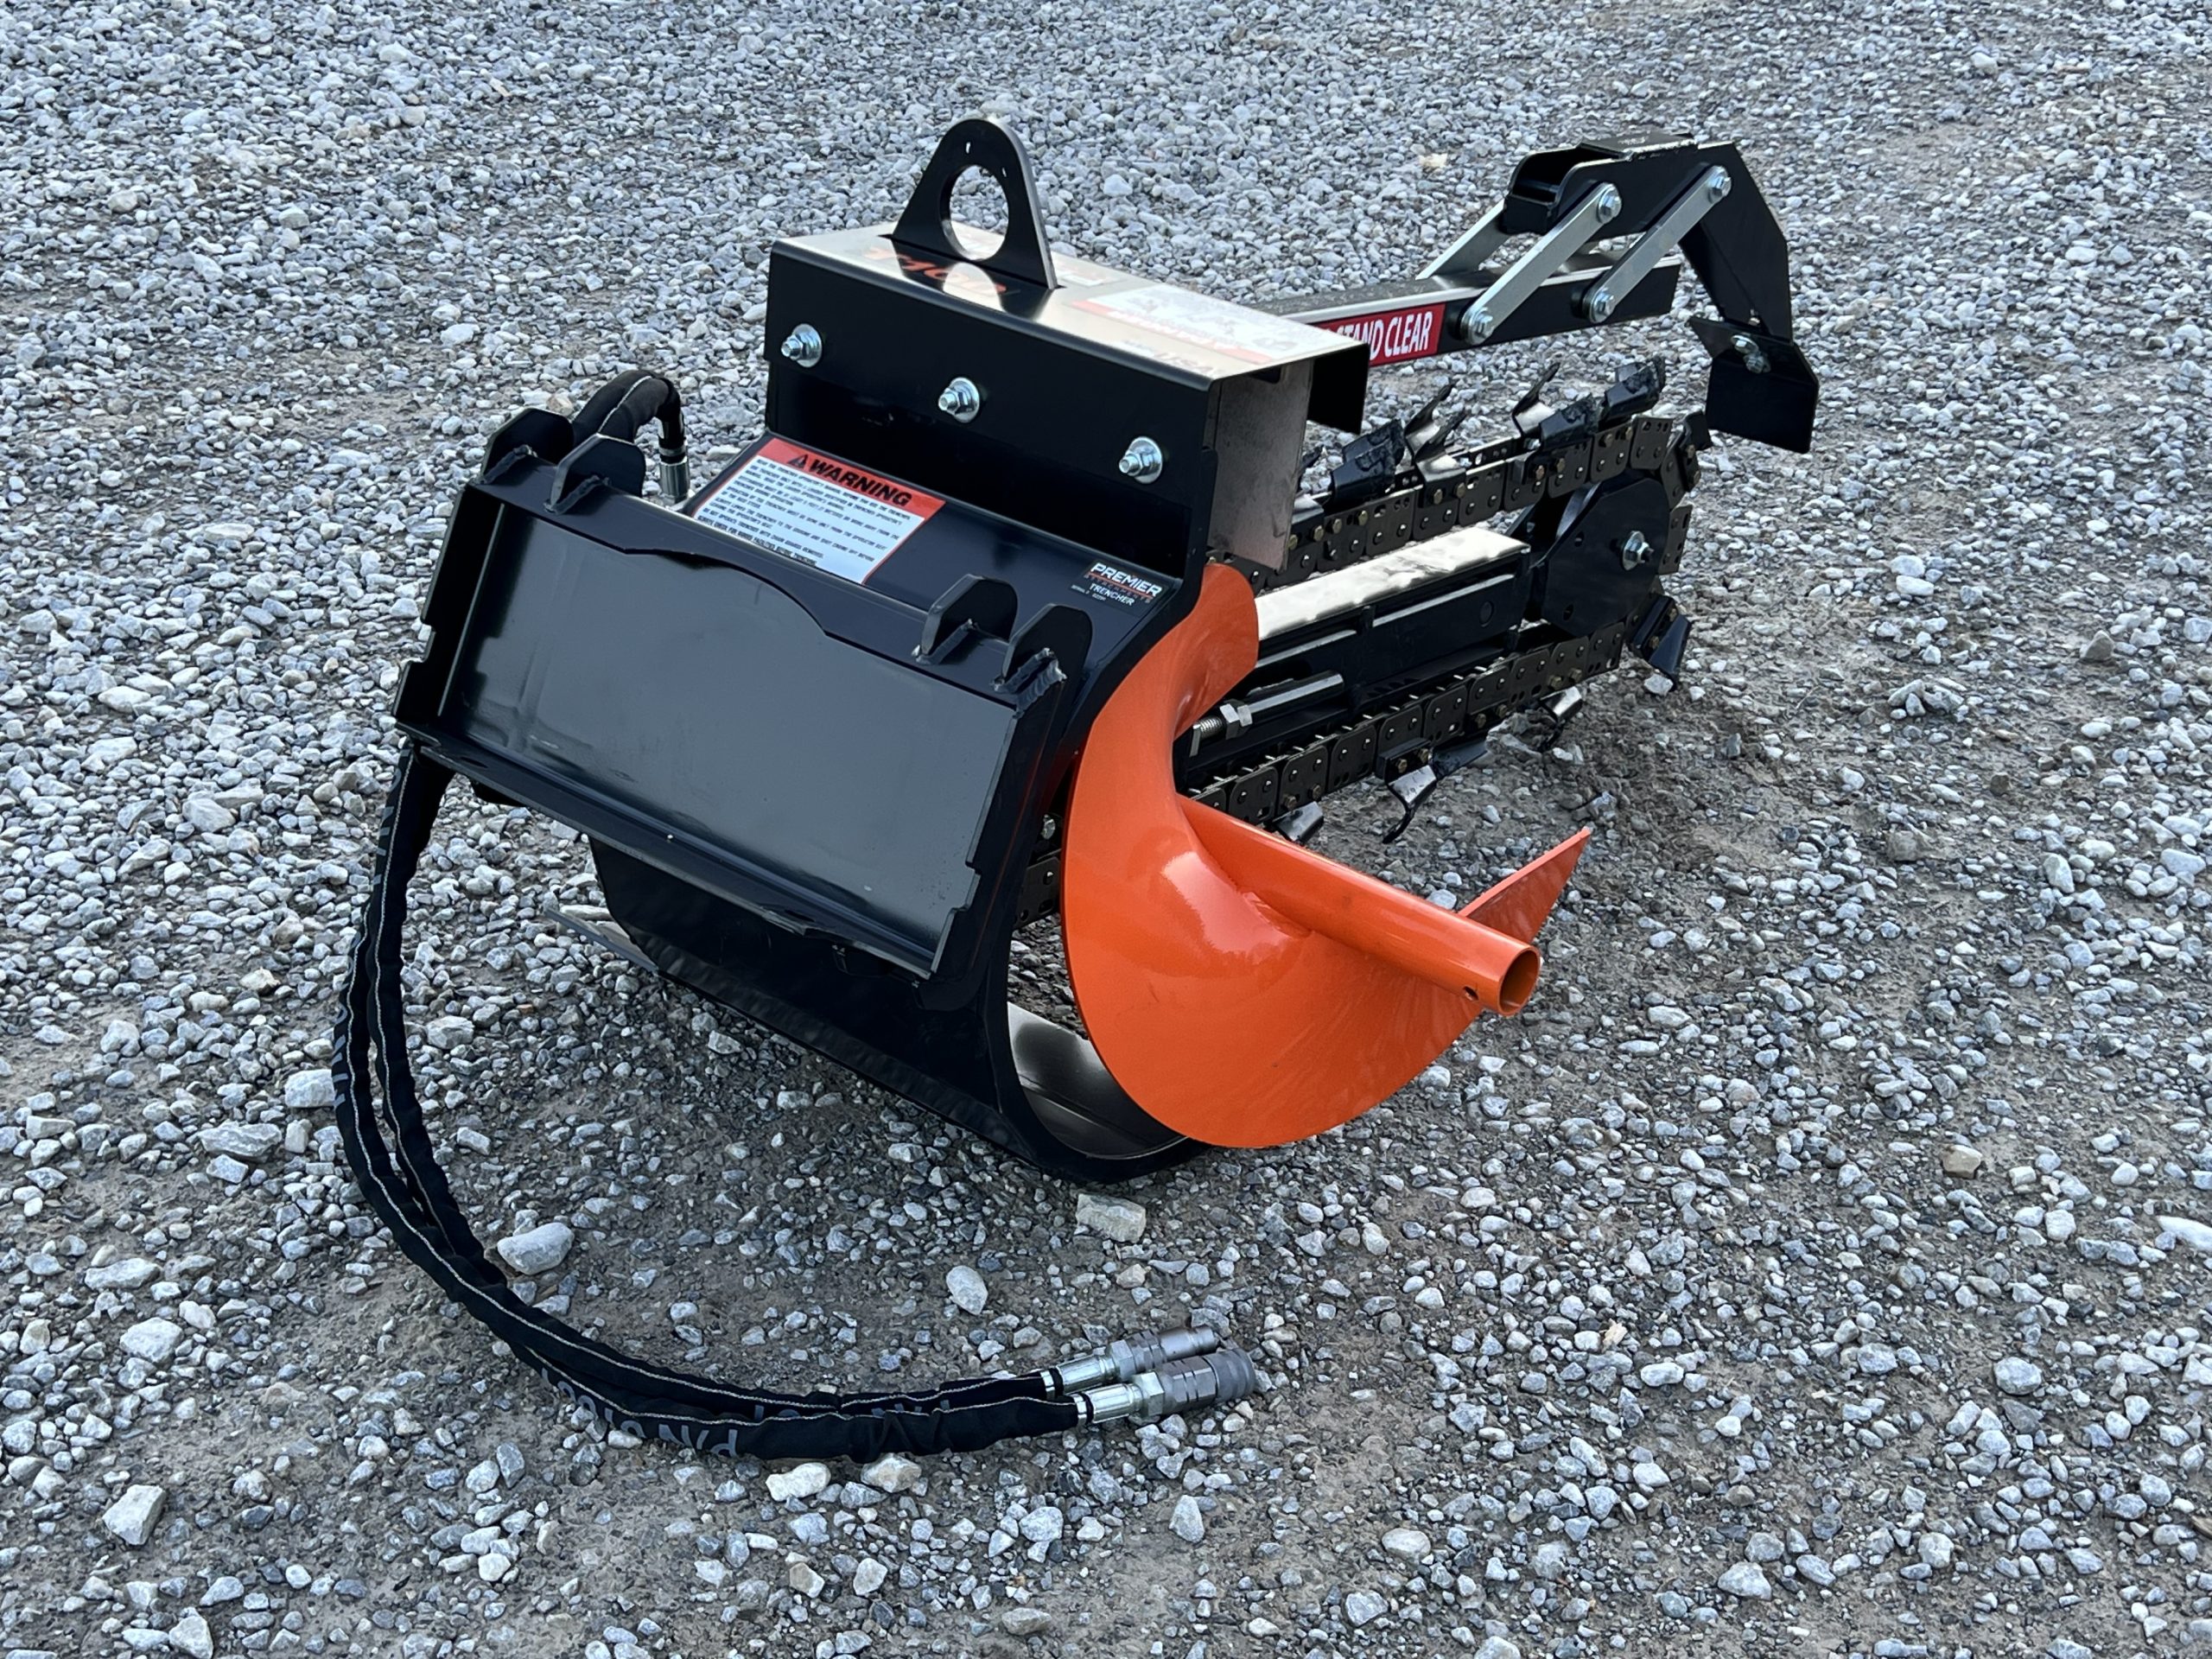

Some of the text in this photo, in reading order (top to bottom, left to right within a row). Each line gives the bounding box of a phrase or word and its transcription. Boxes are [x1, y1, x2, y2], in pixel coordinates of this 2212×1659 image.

[1384, 311, 1433, 358] CLEAR
[809, 459, 912, 506] WARNING
[1089, 582, 1135, 606] TRENCHER
[1090, 563, 1163, 597] PREMIER
